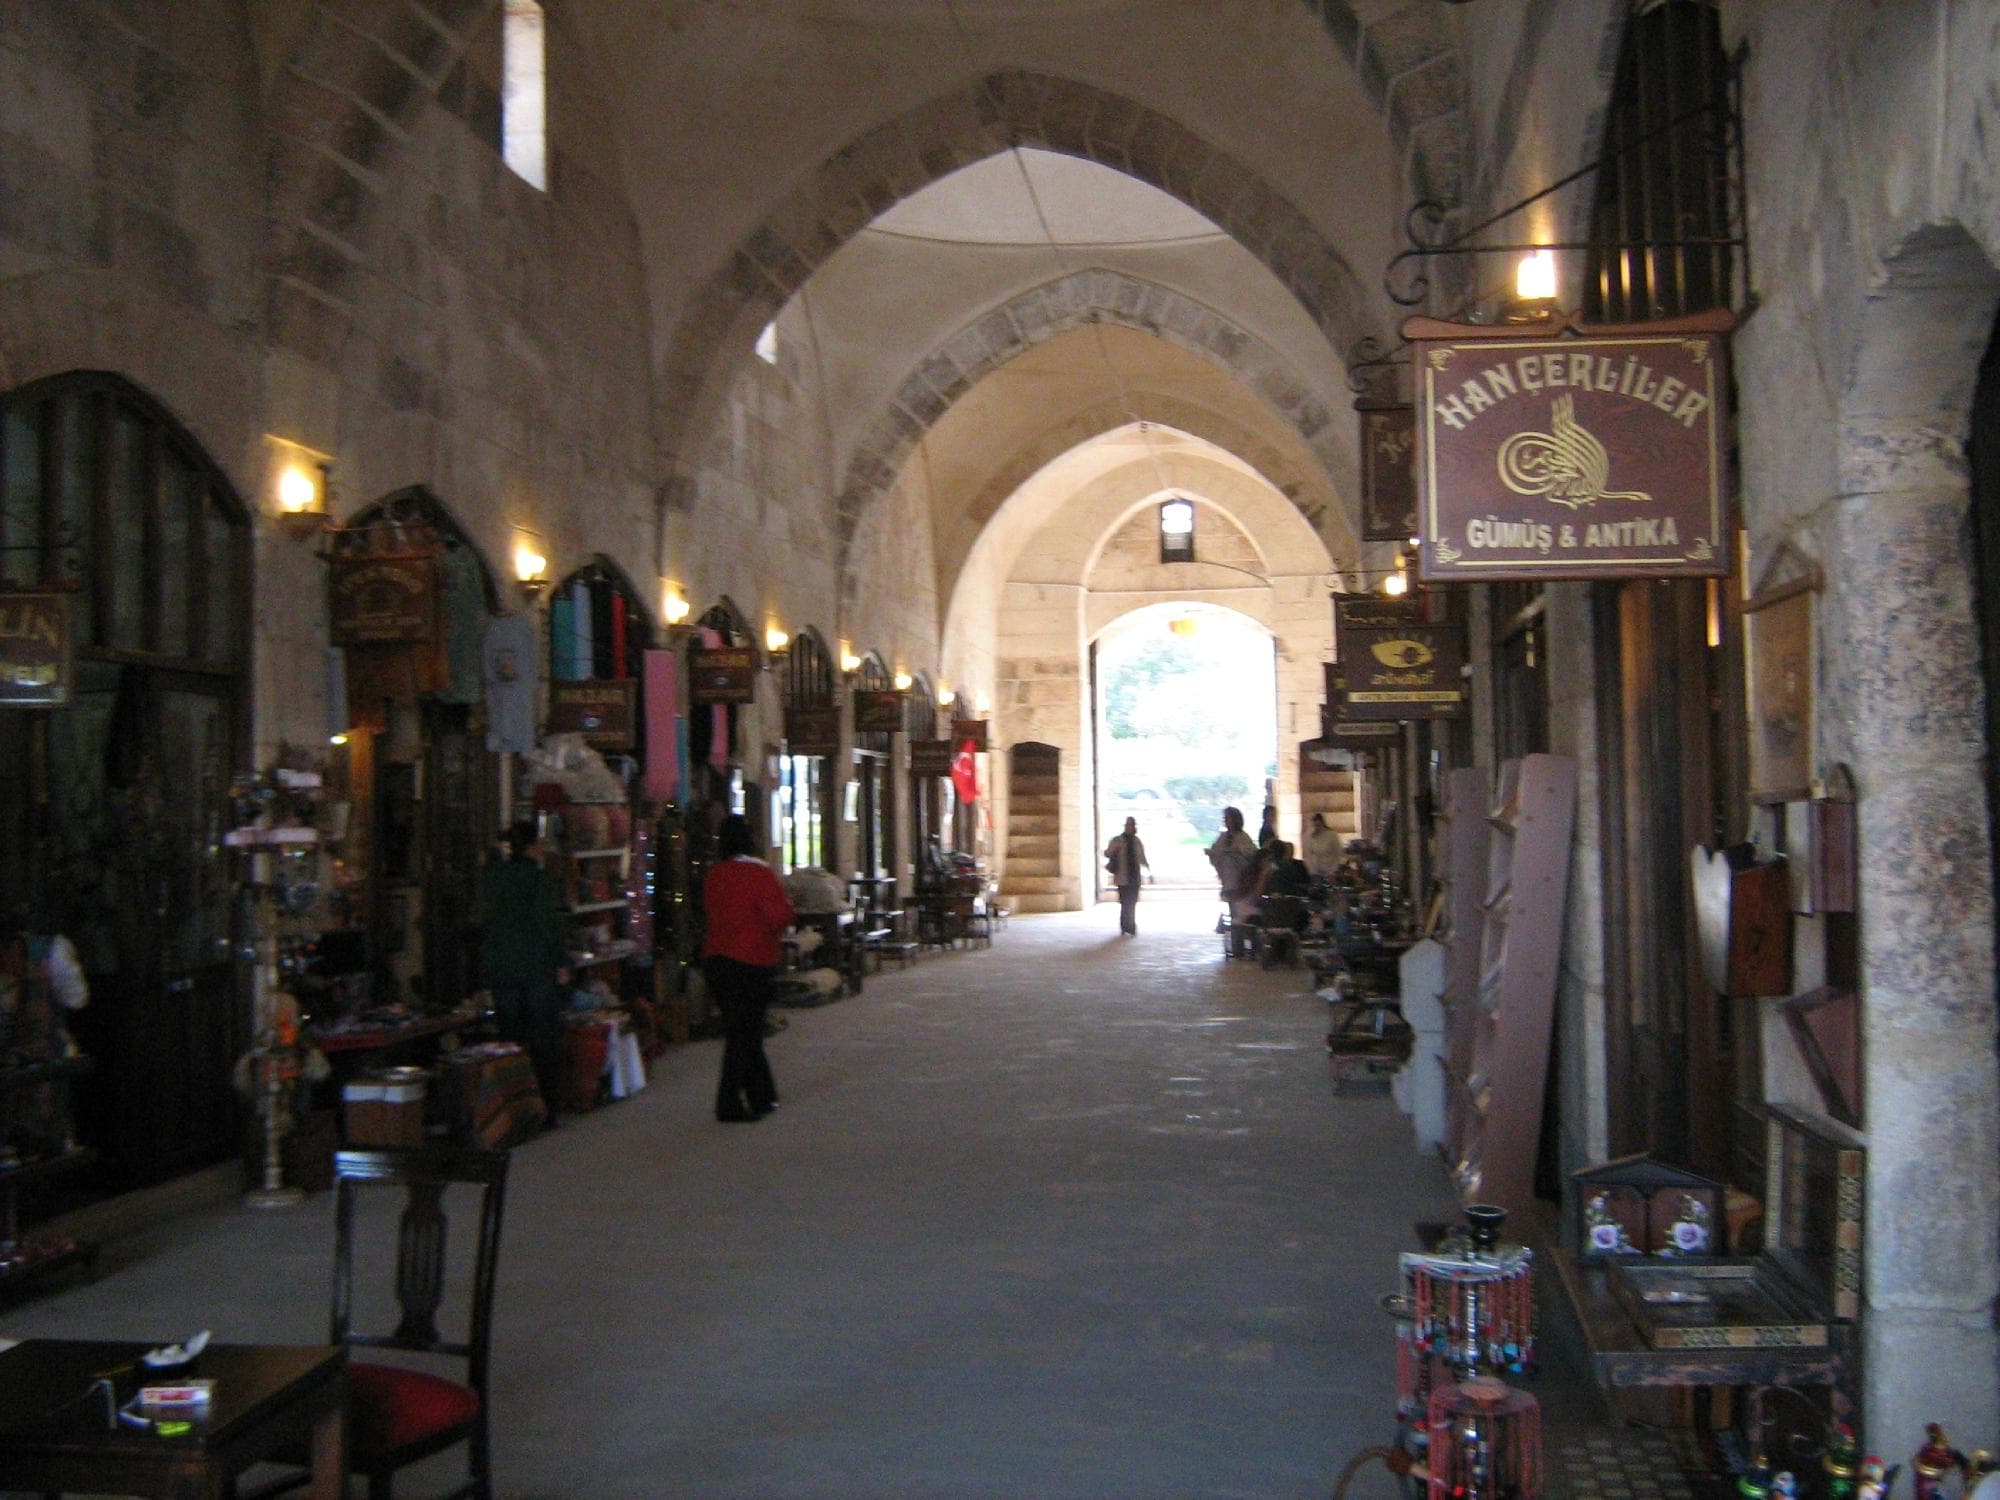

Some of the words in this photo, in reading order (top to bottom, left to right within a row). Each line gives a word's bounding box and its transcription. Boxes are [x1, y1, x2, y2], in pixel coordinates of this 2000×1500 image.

[1434, 353, 1708, 431] HANÇERLİLER
[1466, 514, 1552, 555] GÜMÜŞ
[1559, 524, 1577, 548] &
[1584, 516, 1680, 547] ANTİKA
